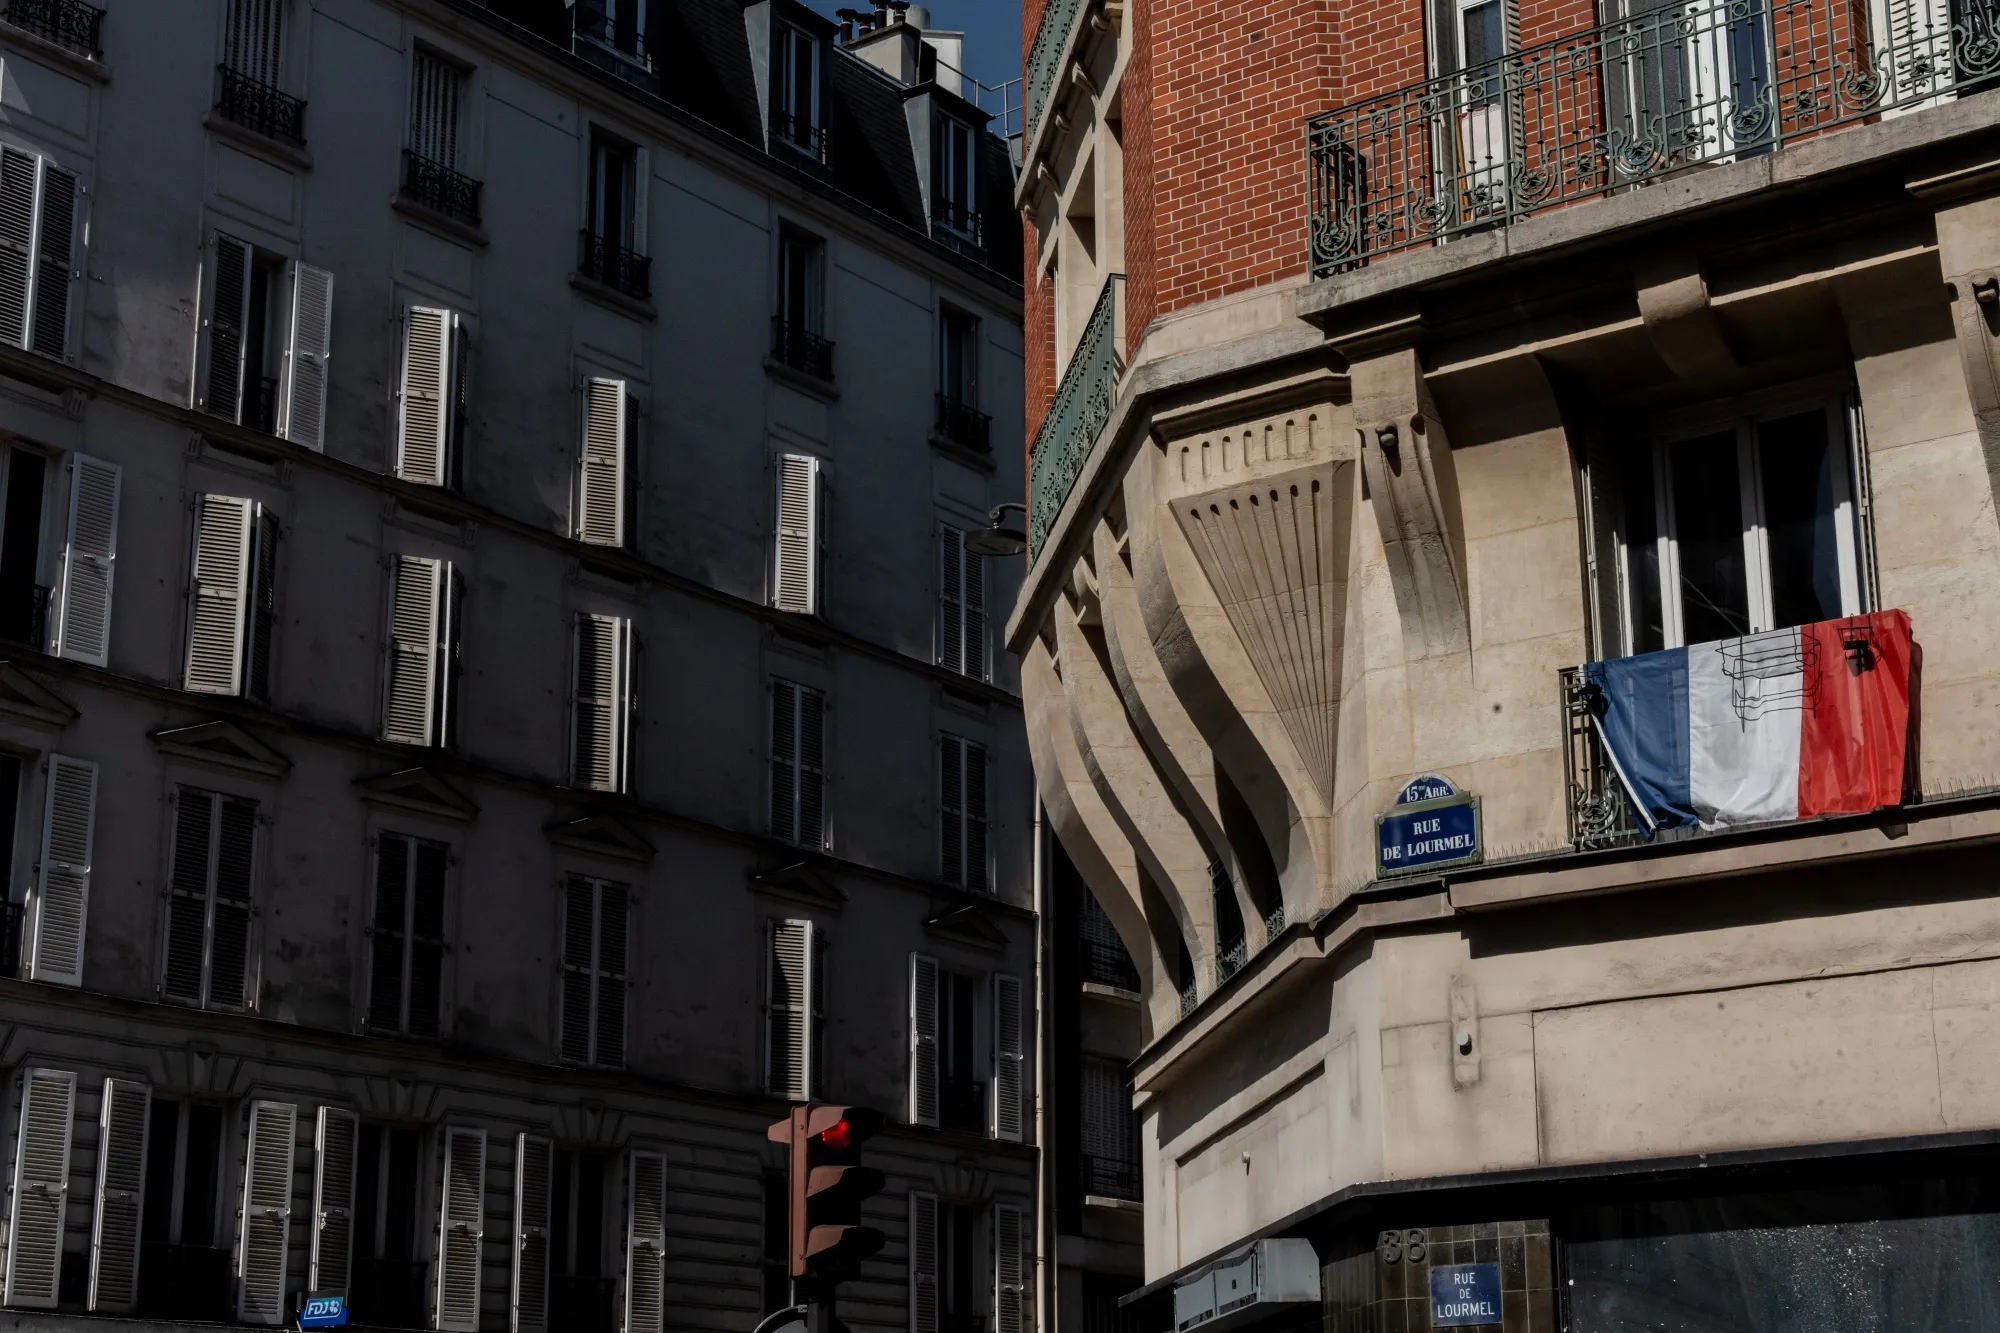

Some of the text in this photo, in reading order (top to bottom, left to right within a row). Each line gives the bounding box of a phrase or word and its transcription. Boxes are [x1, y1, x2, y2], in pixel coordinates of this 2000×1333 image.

[1413, 818, 1441, 836] RUE
[1383, 834, 1474, 861] DE LOURMEL
[1383, 1228, 1427, 1263] 38
[1454, 1272, 1476, 1285] RUE
[1459, 1288, 1472, 1299] DE
[308, 1302, 329, 1316] FDJ
[1437, 1301, 1495, 1318] LOURMEL
